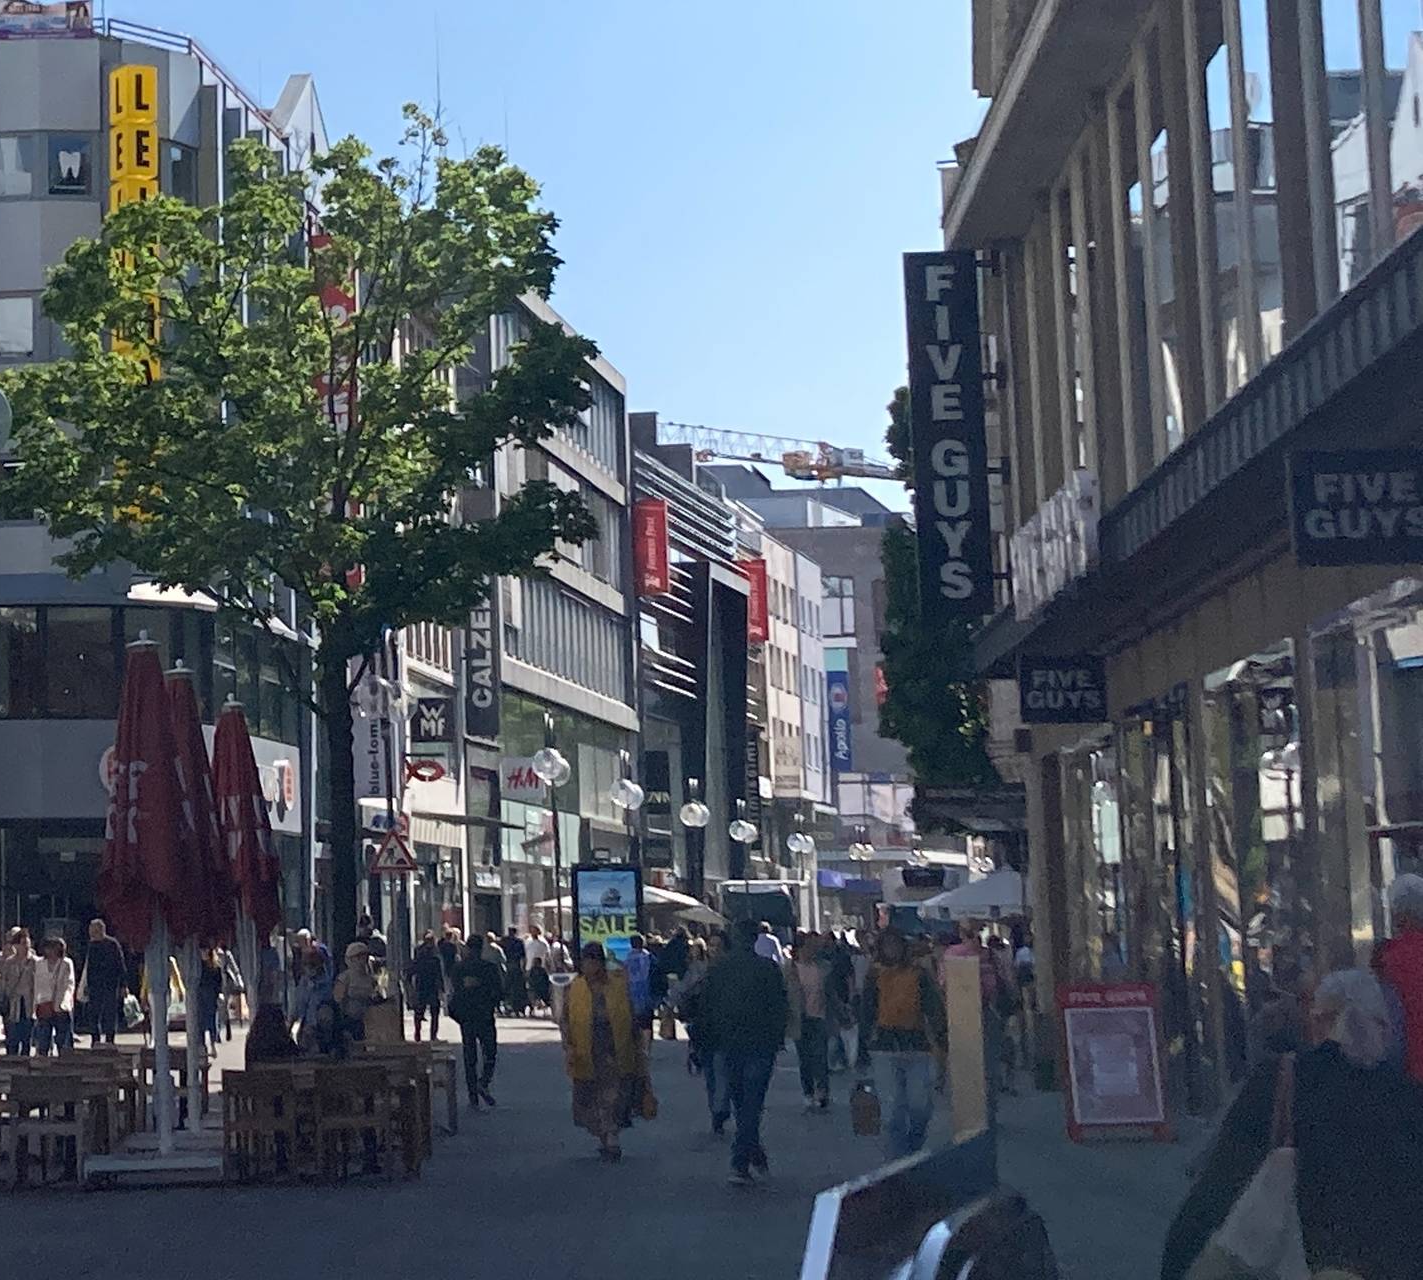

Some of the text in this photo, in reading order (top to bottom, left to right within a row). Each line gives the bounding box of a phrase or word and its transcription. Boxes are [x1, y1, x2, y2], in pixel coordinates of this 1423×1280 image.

[926, 264, 974, 600] FIVE GUYS
[1313, 472, 1421, 503] FIVE
[1030, 669, 1097, 689] FIVE
[1027, 689, 1102, 710] GUYS
[833, 717, 850, 761] Apollo
[578, 912, 638, 936] SALE
